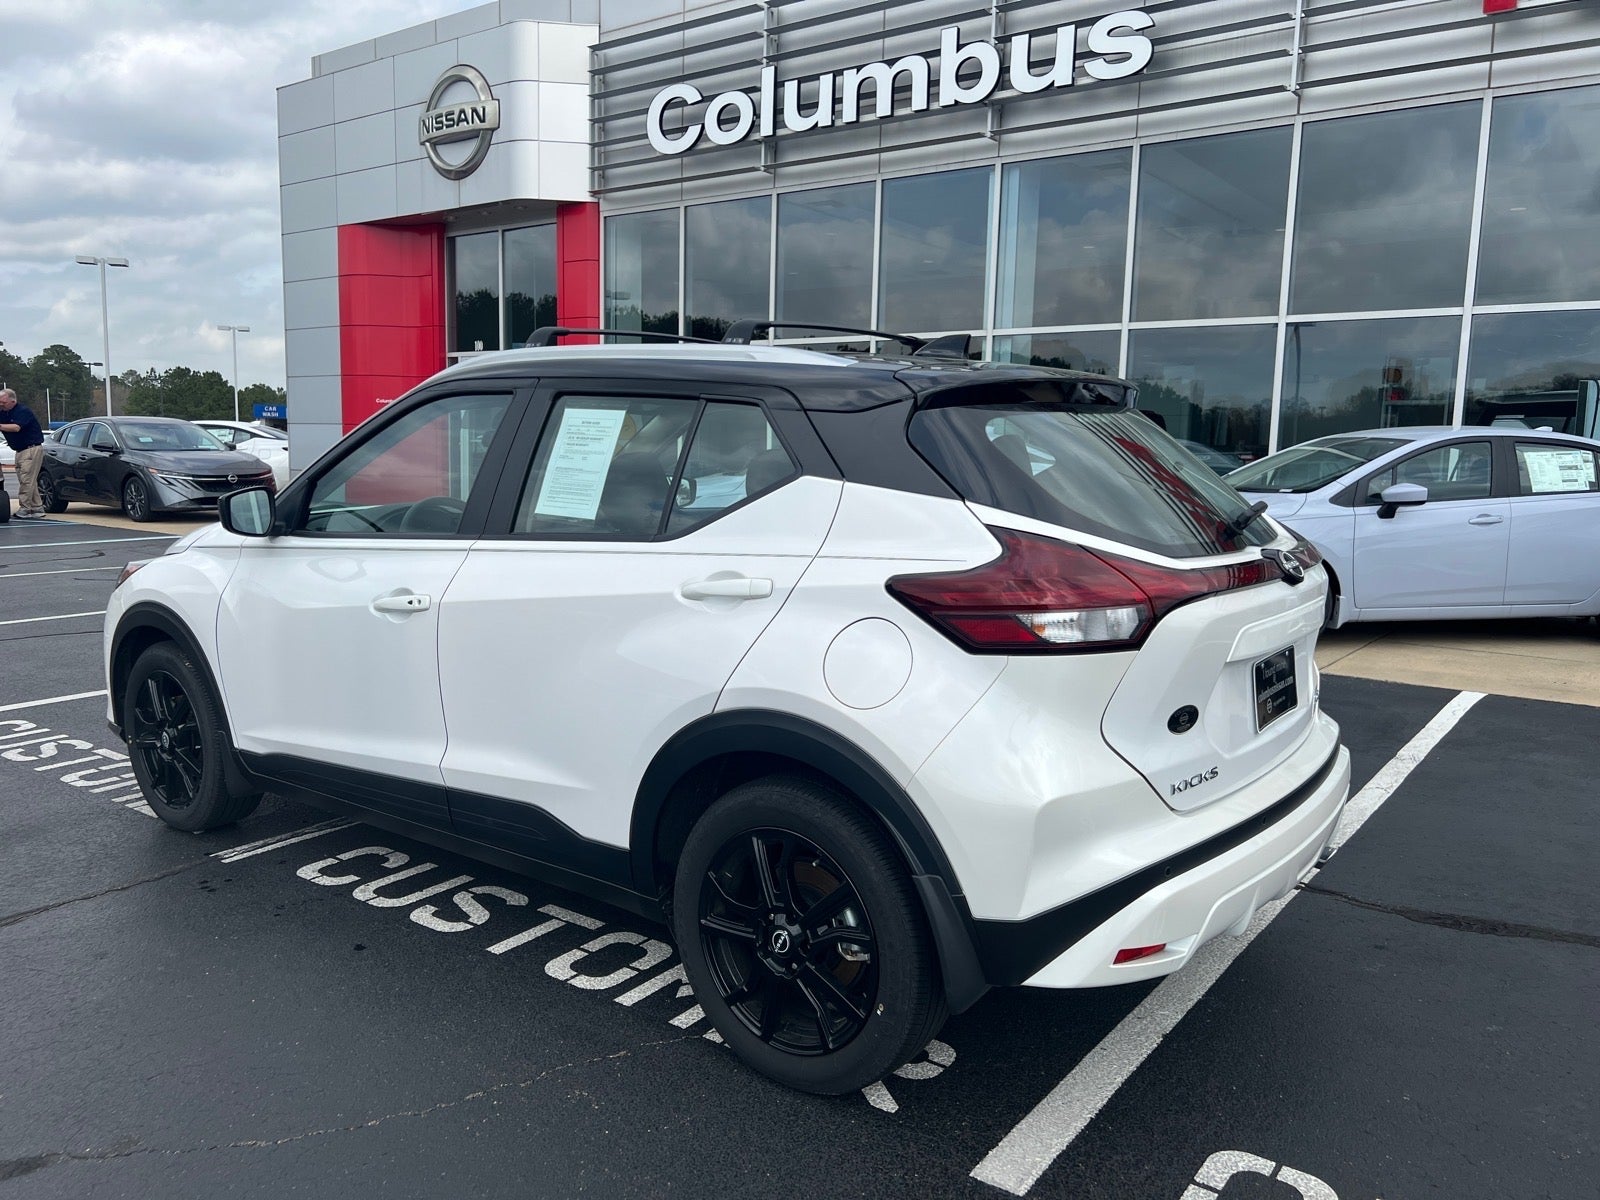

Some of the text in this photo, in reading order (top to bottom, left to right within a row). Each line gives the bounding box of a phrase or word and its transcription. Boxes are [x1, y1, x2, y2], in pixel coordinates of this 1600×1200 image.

[646, 10, 1155, 155] Columbus
[421, 105, 486, 136] NISSAN
[1170, 766, 1219, 796] KICKS
